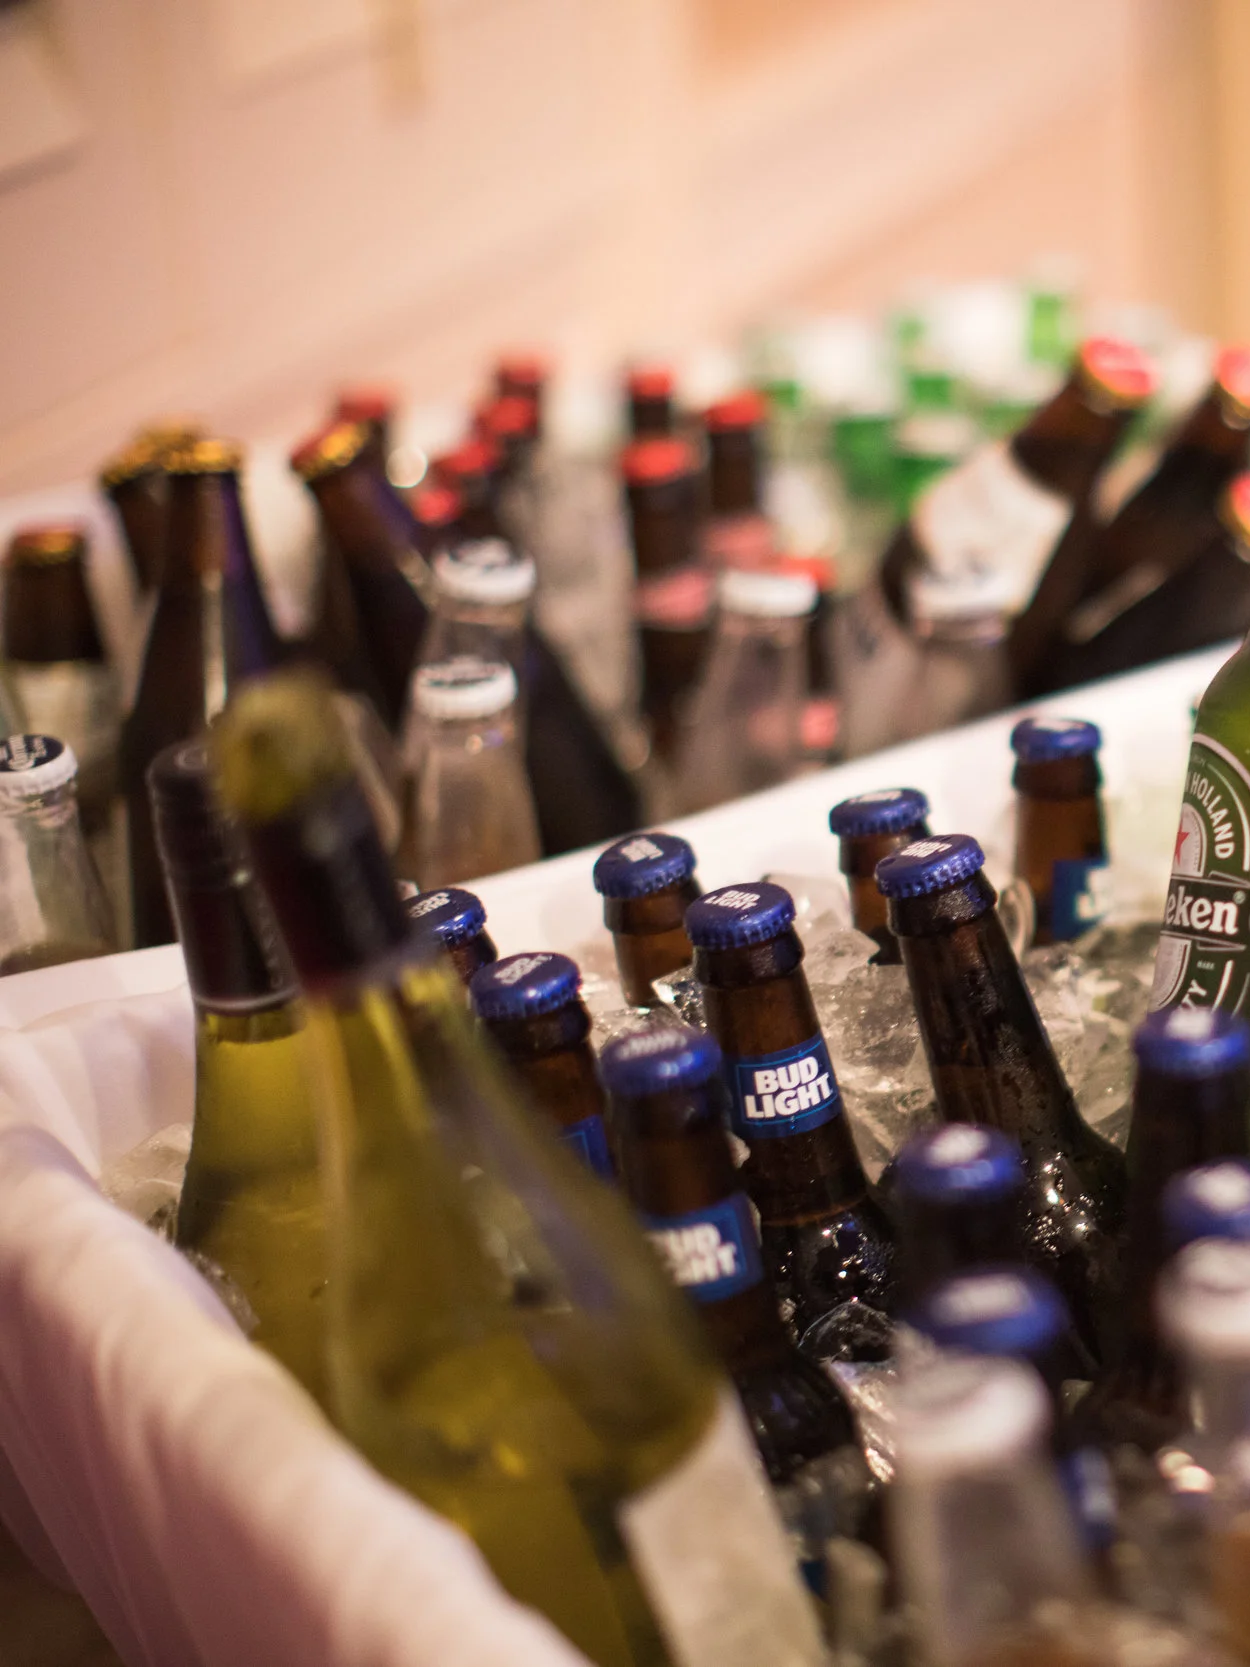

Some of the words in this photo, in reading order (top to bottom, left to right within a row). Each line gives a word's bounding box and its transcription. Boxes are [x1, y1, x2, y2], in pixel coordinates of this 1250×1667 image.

[1191, 773, 1236, 860] HOLLAND
[1165, 885, 1239, 936] eken
[744, 1072, 830, 1119] LIGHT
[754, 1056, 819, 1095] BUD
[655, 1222, 721, 1262] UD
